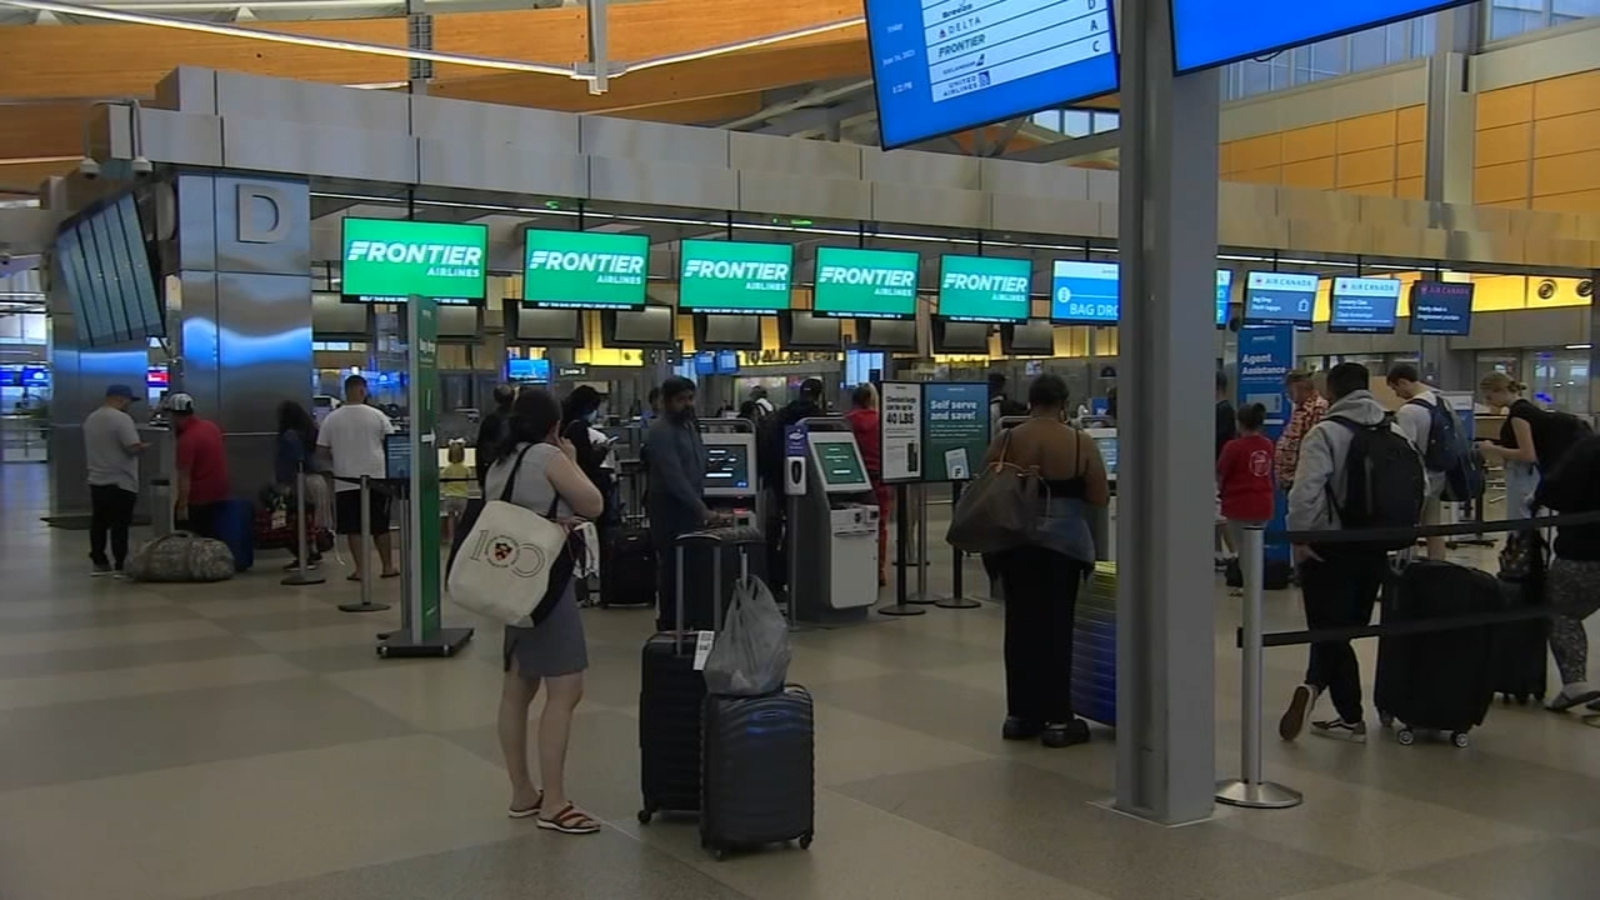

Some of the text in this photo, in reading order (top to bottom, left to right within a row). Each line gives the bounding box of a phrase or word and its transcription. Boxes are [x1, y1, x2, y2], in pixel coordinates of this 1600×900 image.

[948, 16, 981, 35] DELTA
[1090, 19, 1100, 31] A
[938, 33, 986, 58] FRONTIER
[1092, 40, 1101, 53] C
[235, 184, 292, 243] D
[347, 240, 482, 266] FRONTIER
[529, 250, 645, 274] FRONTIER
[426, 267, 481, 278] AIRLINES
[684, 259, 789, 281] FRONTIER
[818, 266, 915, 287] FRONTIER
[596, 274, 641, 285] AIRLINES
[942, 273, 1029, 293] FRONTIER
[1364, 283, 1395, 292] CANADA
[1069, 302, 1095, 316] BAG
[1241, 353, 1272, 365] Agent
[1241, 366, 1286, 375] Assistance
[930, 399, 977, 411] Self serve
[886, 412, 916, 425] 40 LBS
[930, 410, 950, 421] and
